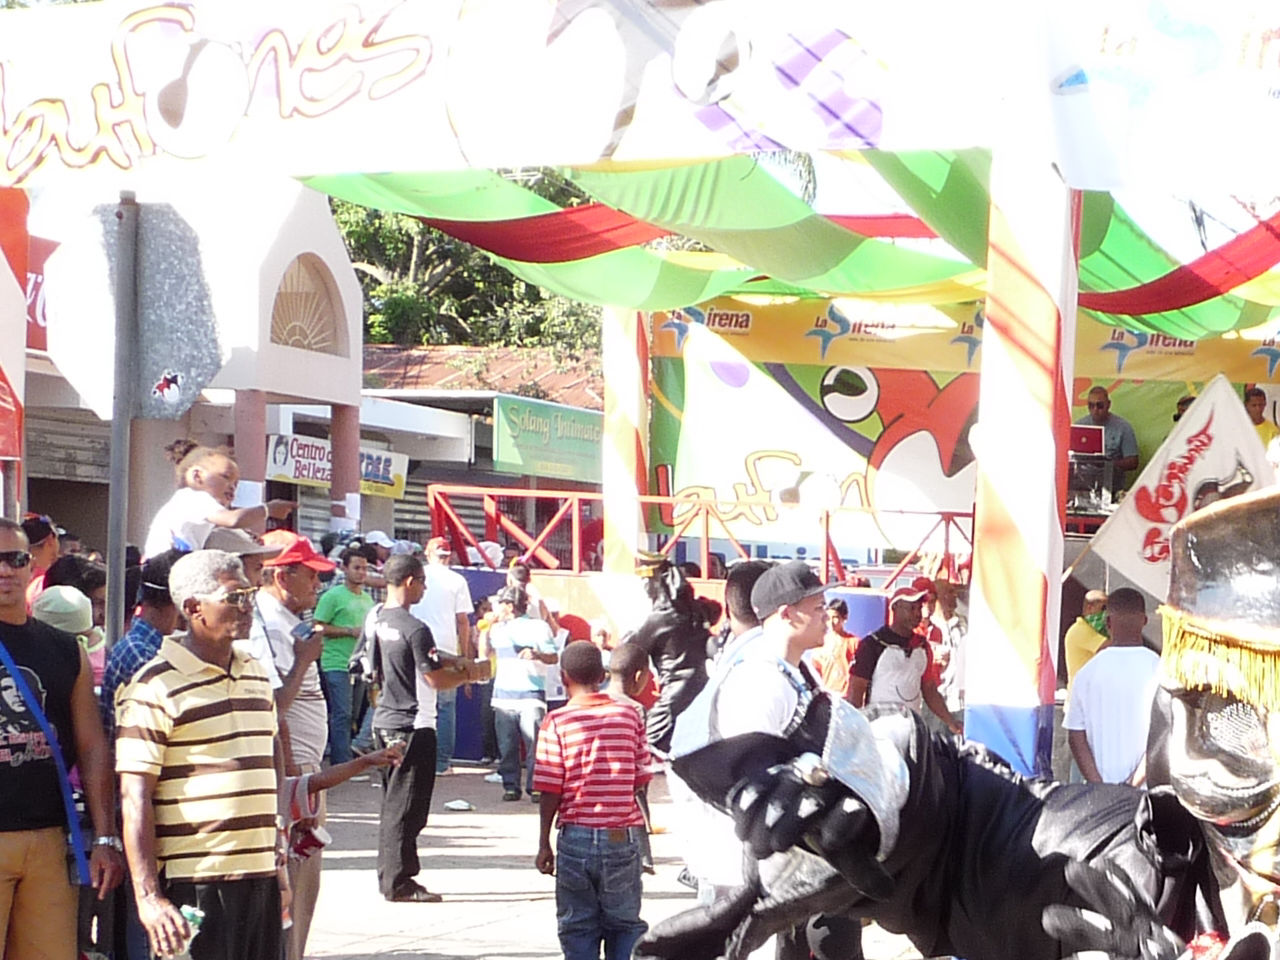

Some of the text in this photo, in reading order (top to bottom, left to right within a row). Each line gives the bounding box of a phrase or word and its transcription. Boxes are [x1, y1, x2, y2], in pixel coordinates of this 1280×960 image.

[815, 316, 828, 329] La
[961, 322, 974, 335] La
[1111, 328, 1125, 342] La
[290, 437, 326, 462] Centro
[293, 459, 332, 481] Belleza
